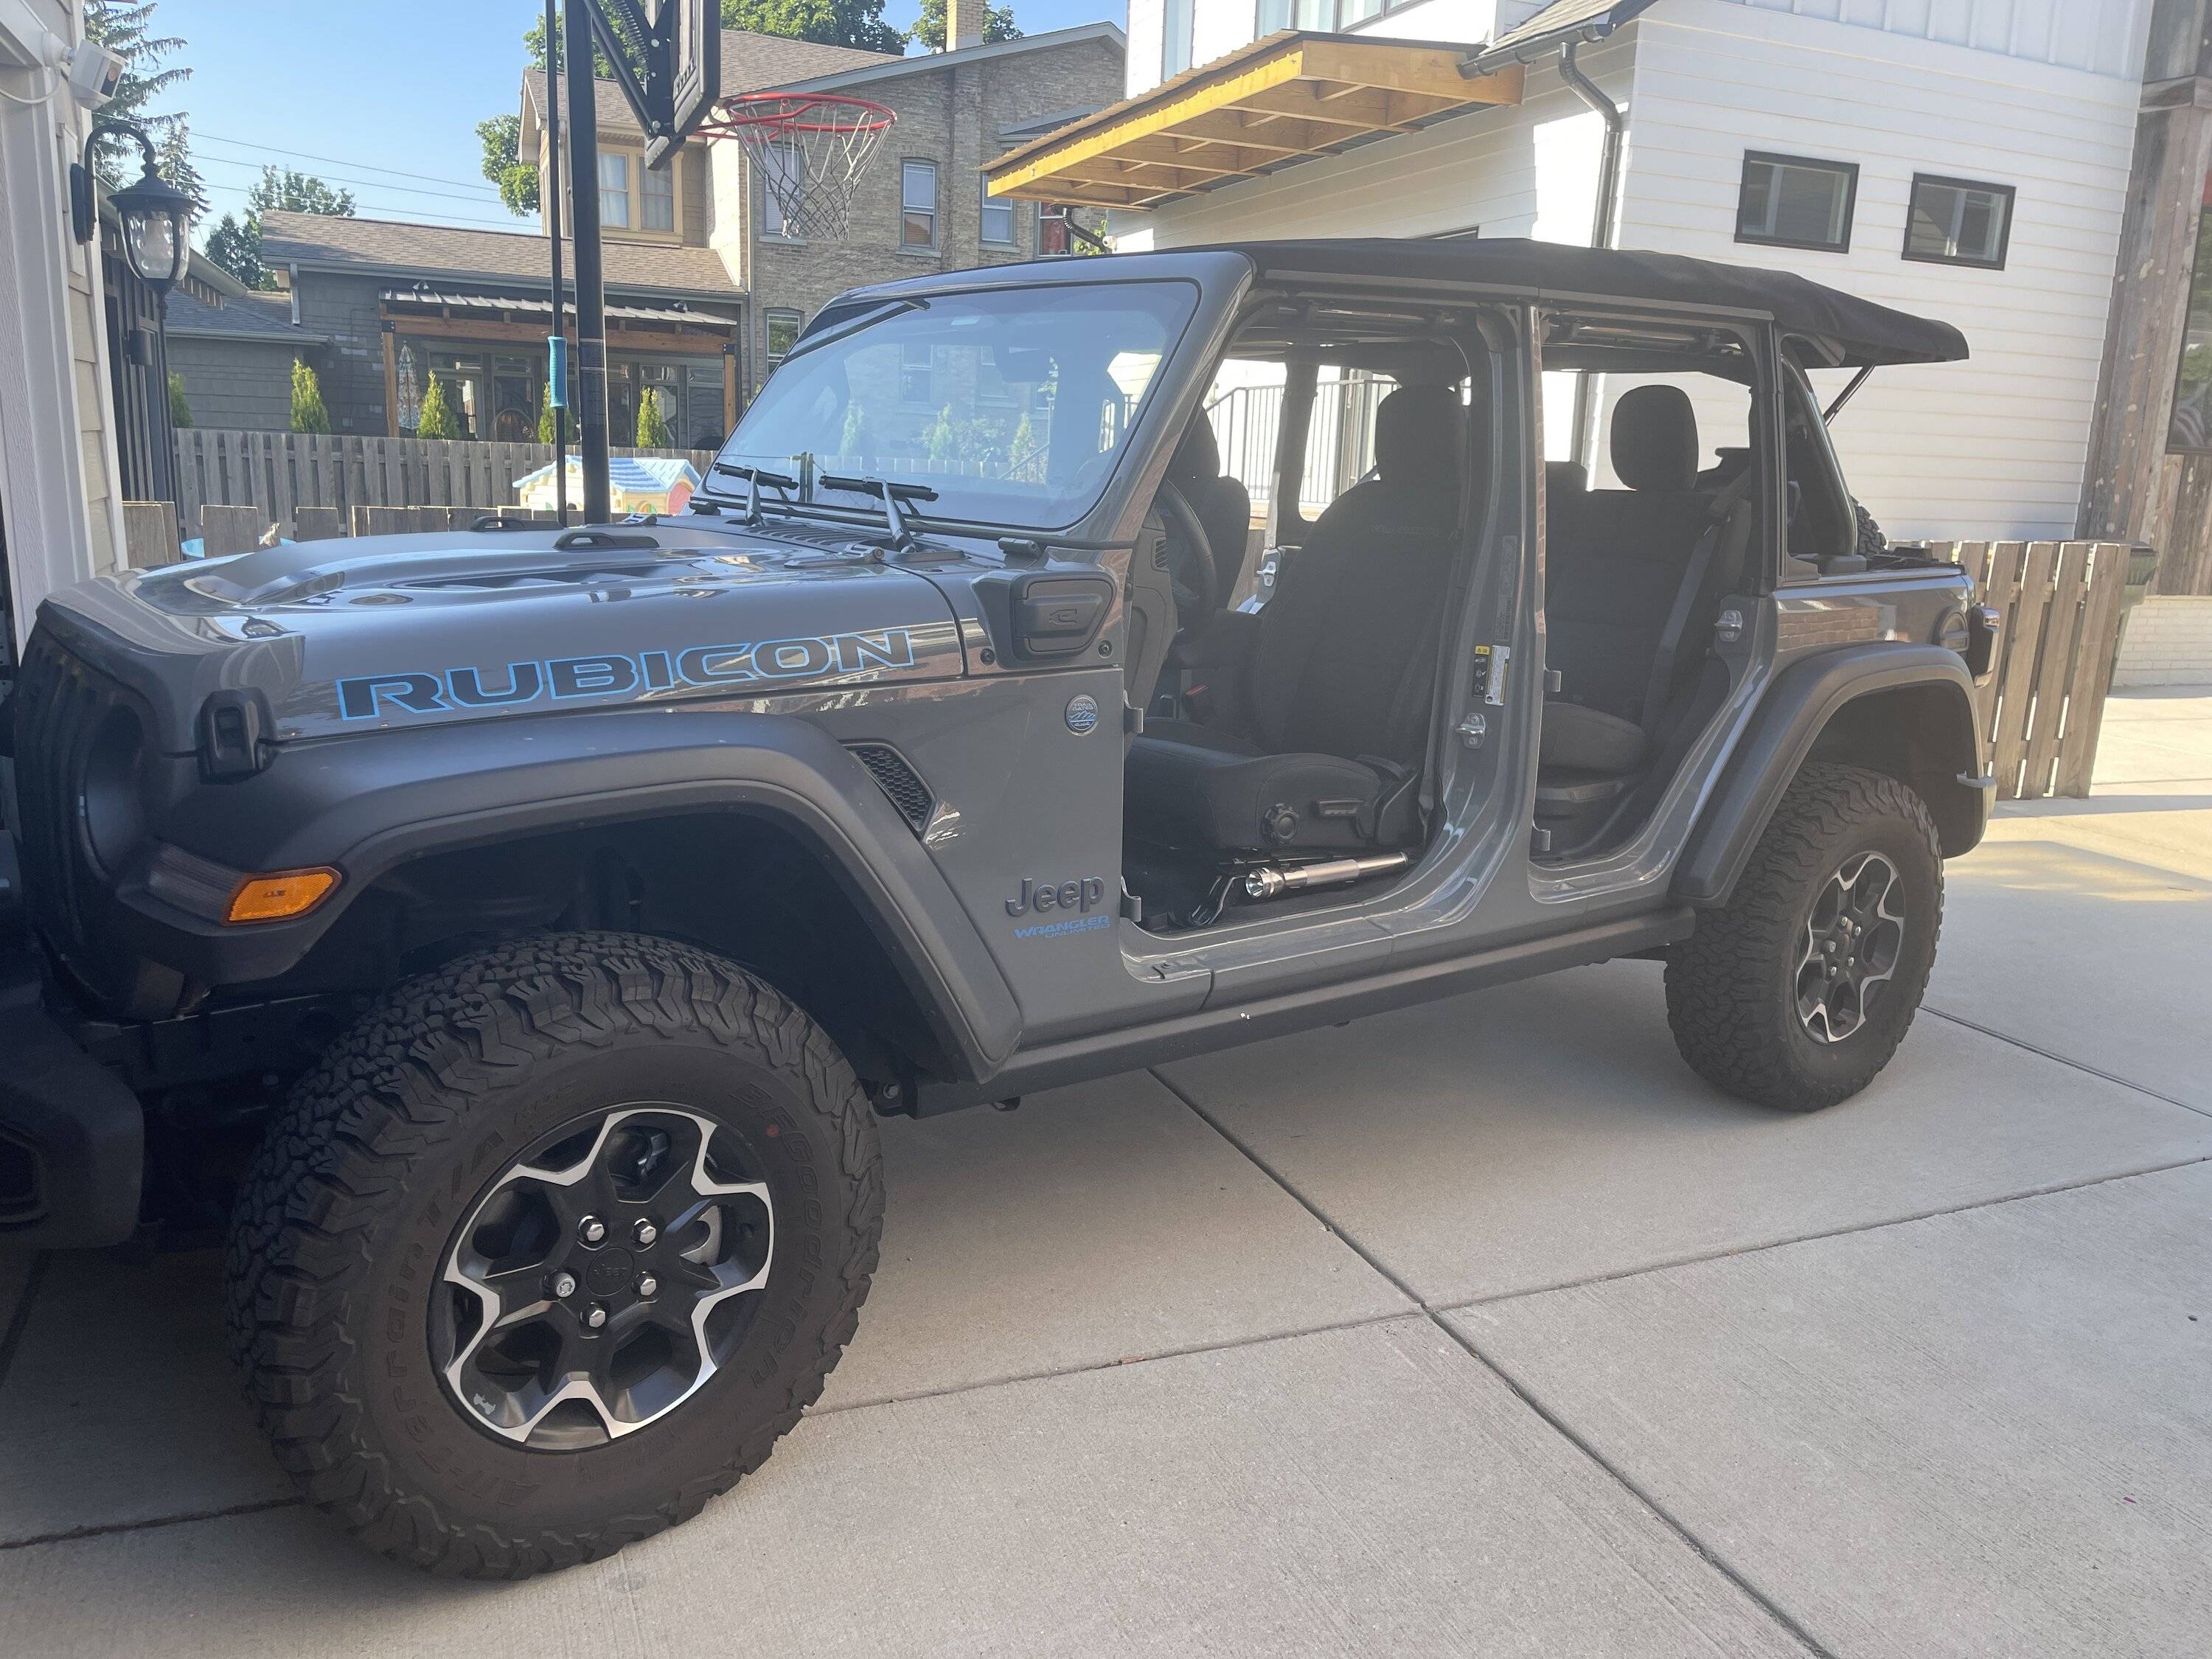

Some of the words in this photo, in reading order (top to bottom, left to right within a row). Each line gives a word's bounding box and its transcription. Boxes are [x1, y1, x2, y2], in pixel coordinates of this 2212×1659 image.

[335, 630, 914, 721] RUBICON
[1005, 876, 1105, 917] Jeep
[1014, 915, 1110, 939] WRANGLER
